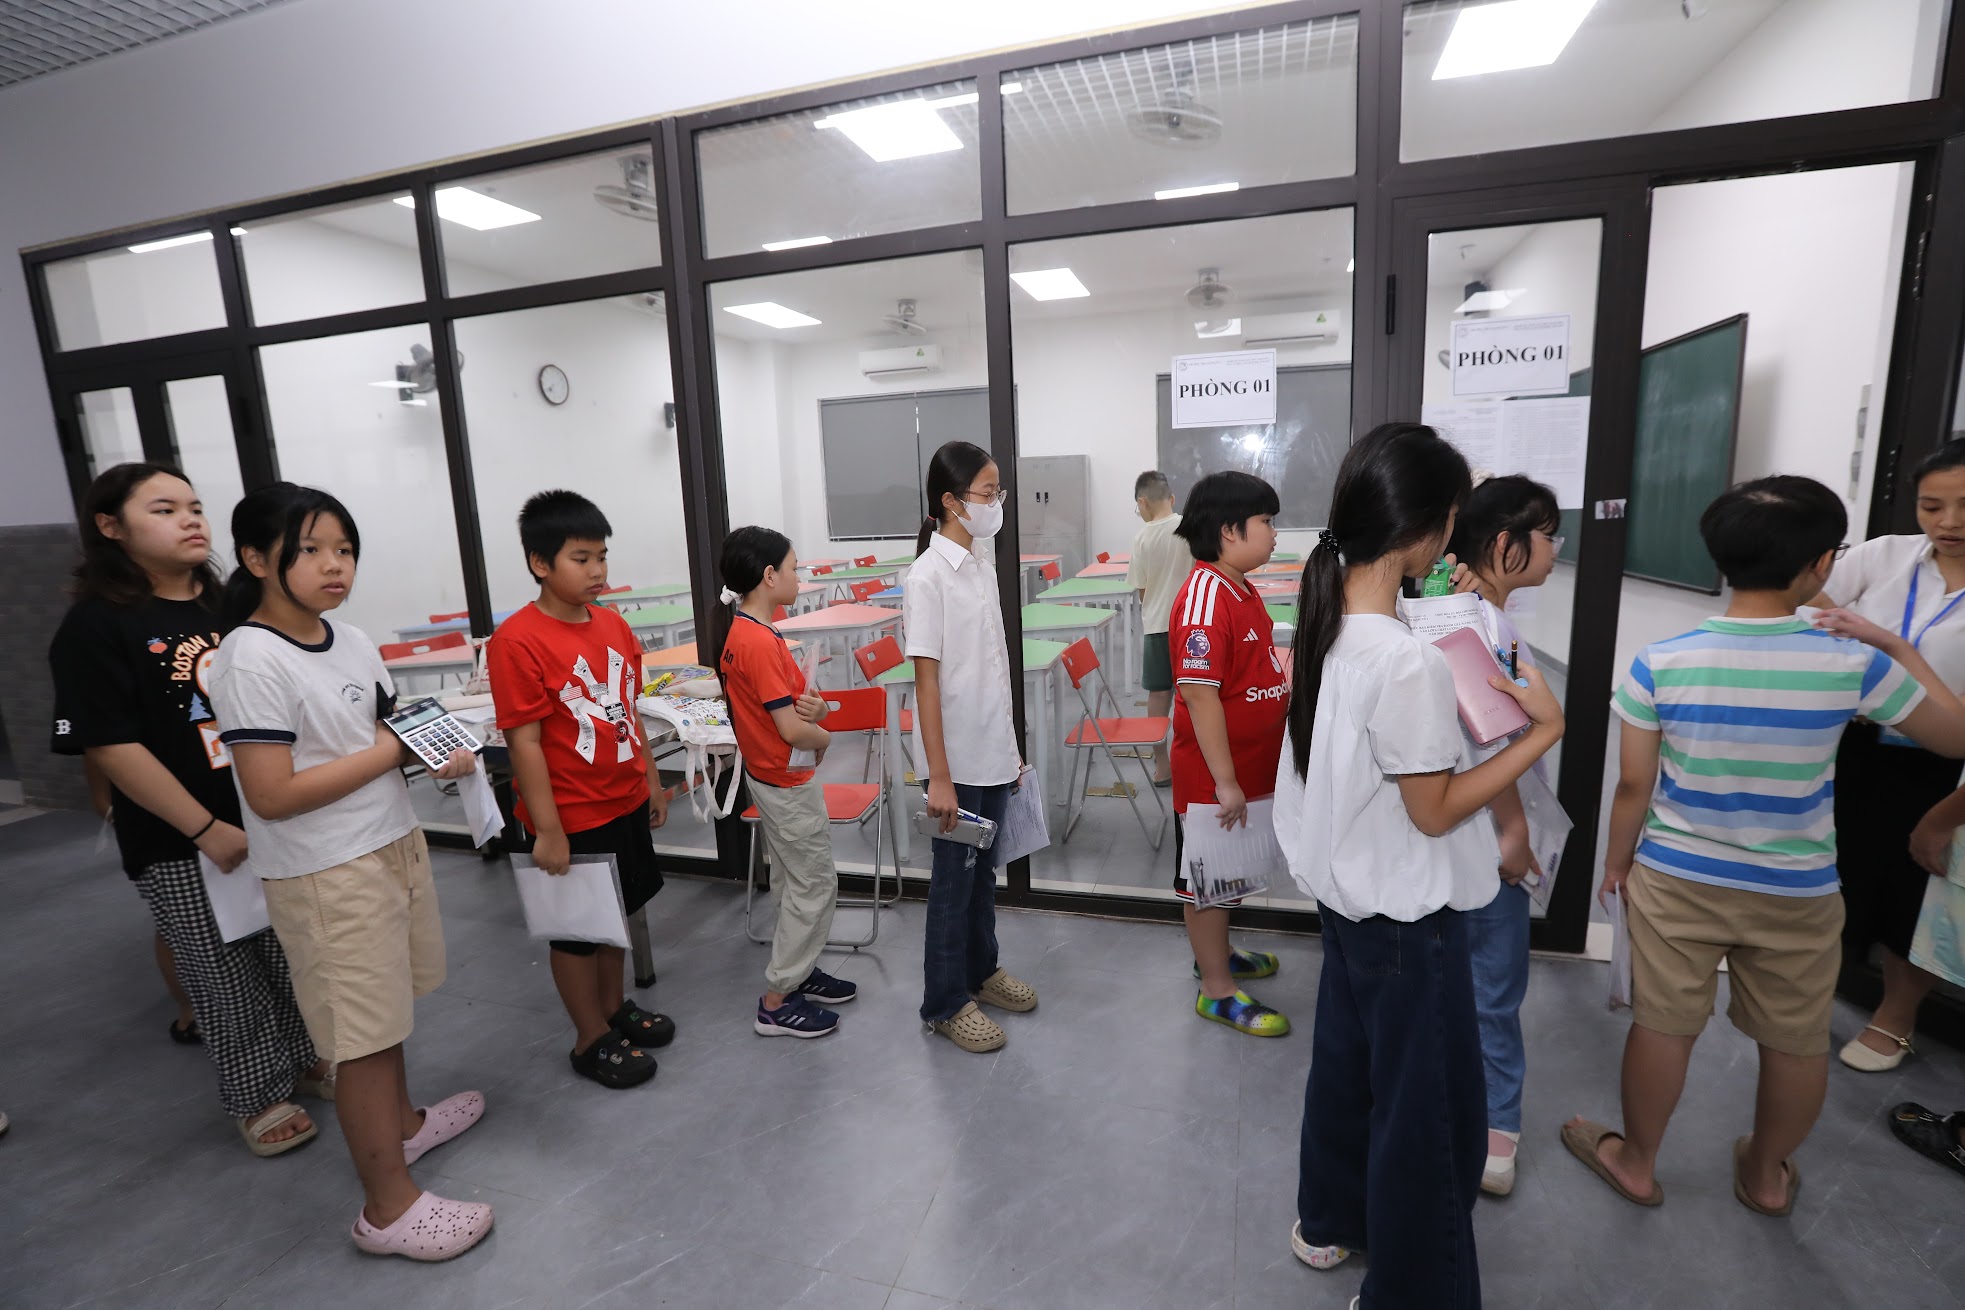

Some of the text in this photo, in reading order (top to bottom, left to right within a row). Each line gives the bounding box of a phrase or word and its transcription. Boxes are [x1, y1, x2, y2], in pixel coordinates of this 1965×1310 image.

[1458, 345, 1564, 367] PHÒNG 01
[1179, 378, 1271, 398] PHÒNG 01
[171, 634, 210, 681] BOSTON
[723, 648, 734, 665] An
[1245, 679, 1289, 702] Snapd
[55, 719, 72, 735] B
